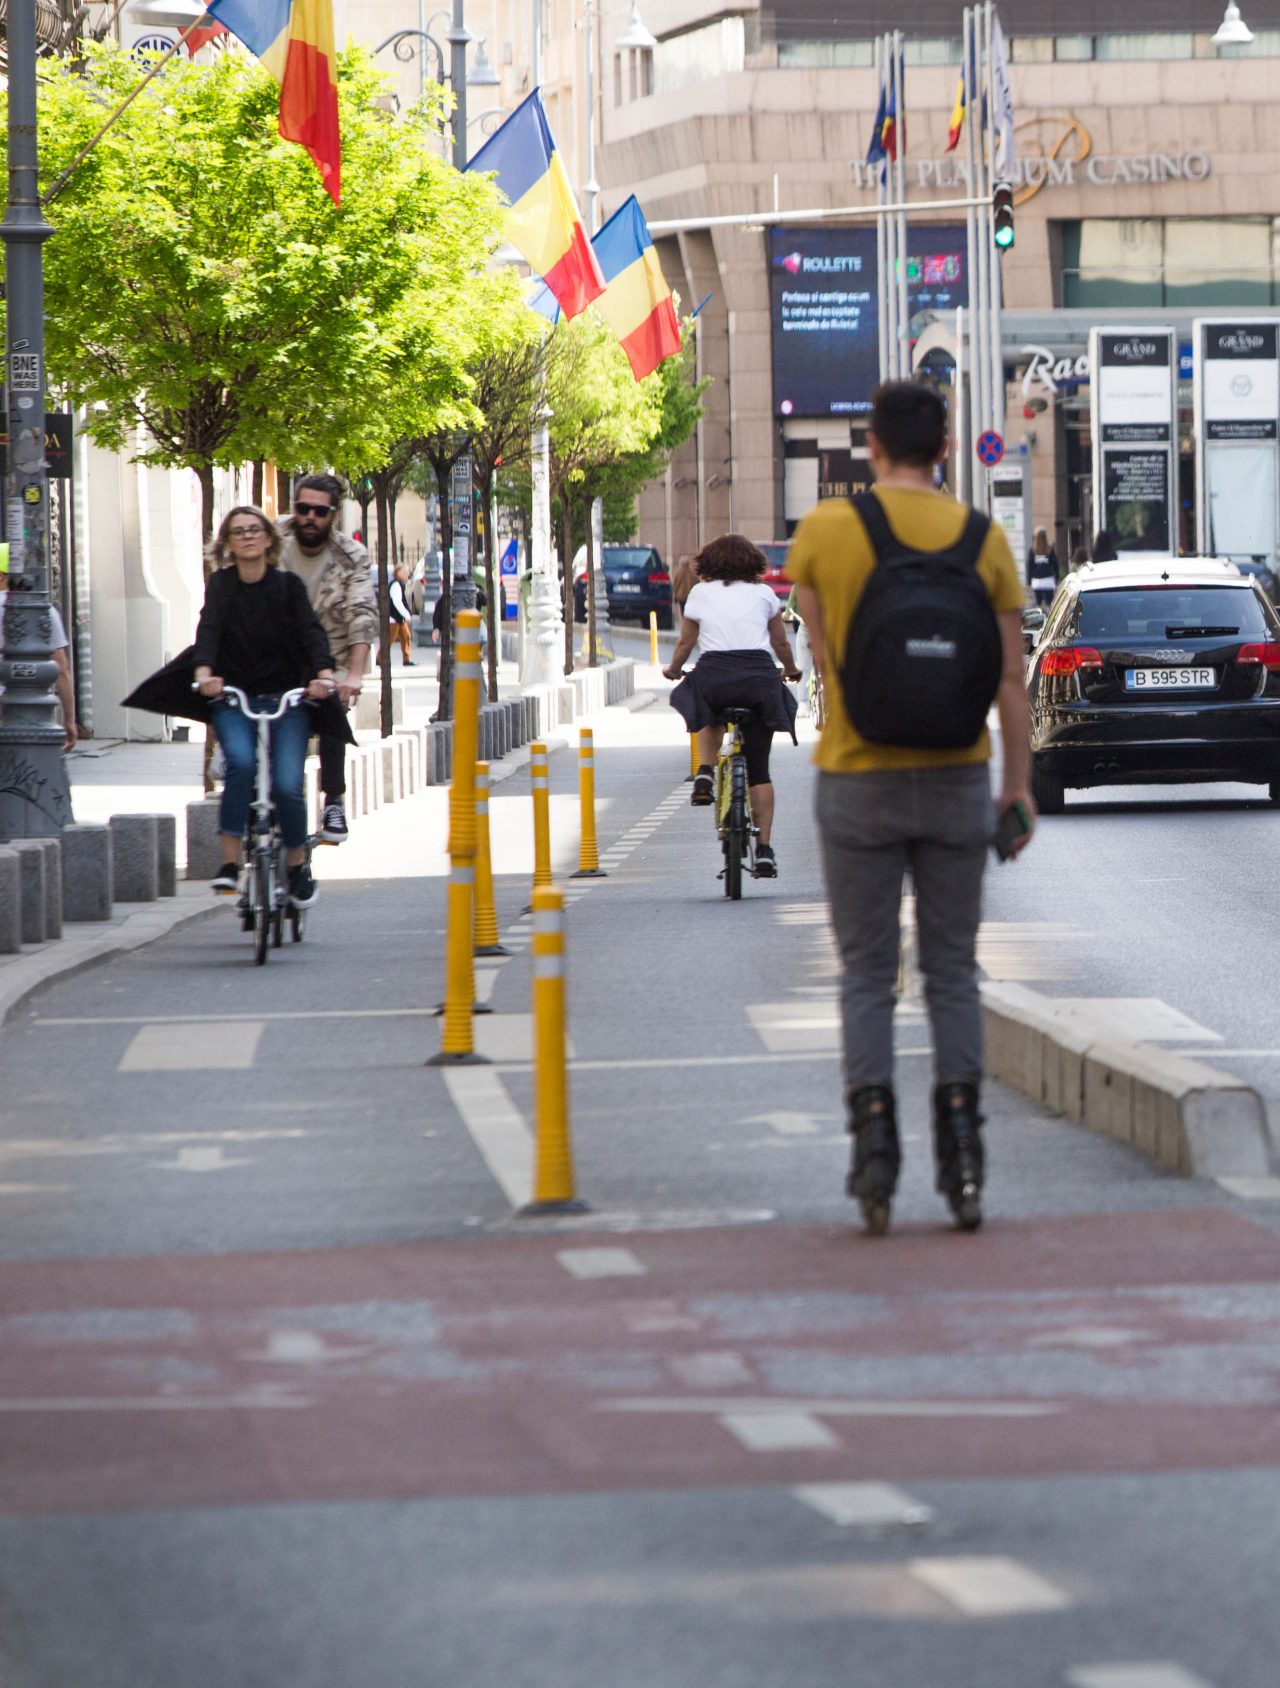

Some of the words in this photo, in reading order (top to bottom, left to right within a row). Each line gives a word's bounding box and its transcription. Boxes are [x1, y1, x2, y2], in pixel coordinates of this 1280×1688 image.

[848, 160, 905, 188] TH
[917, 159, 1074, 187] PLAUM
[1087, 154, 1211, 187] CASINO
[803, 256, 862, 273] ROULETTE
[13, 356, 37, 371] BNE
[1136, 672, 1146, 685] B
[1151, 671, 1177, 684] 595
[1180, 670, 1210, 684] STR
